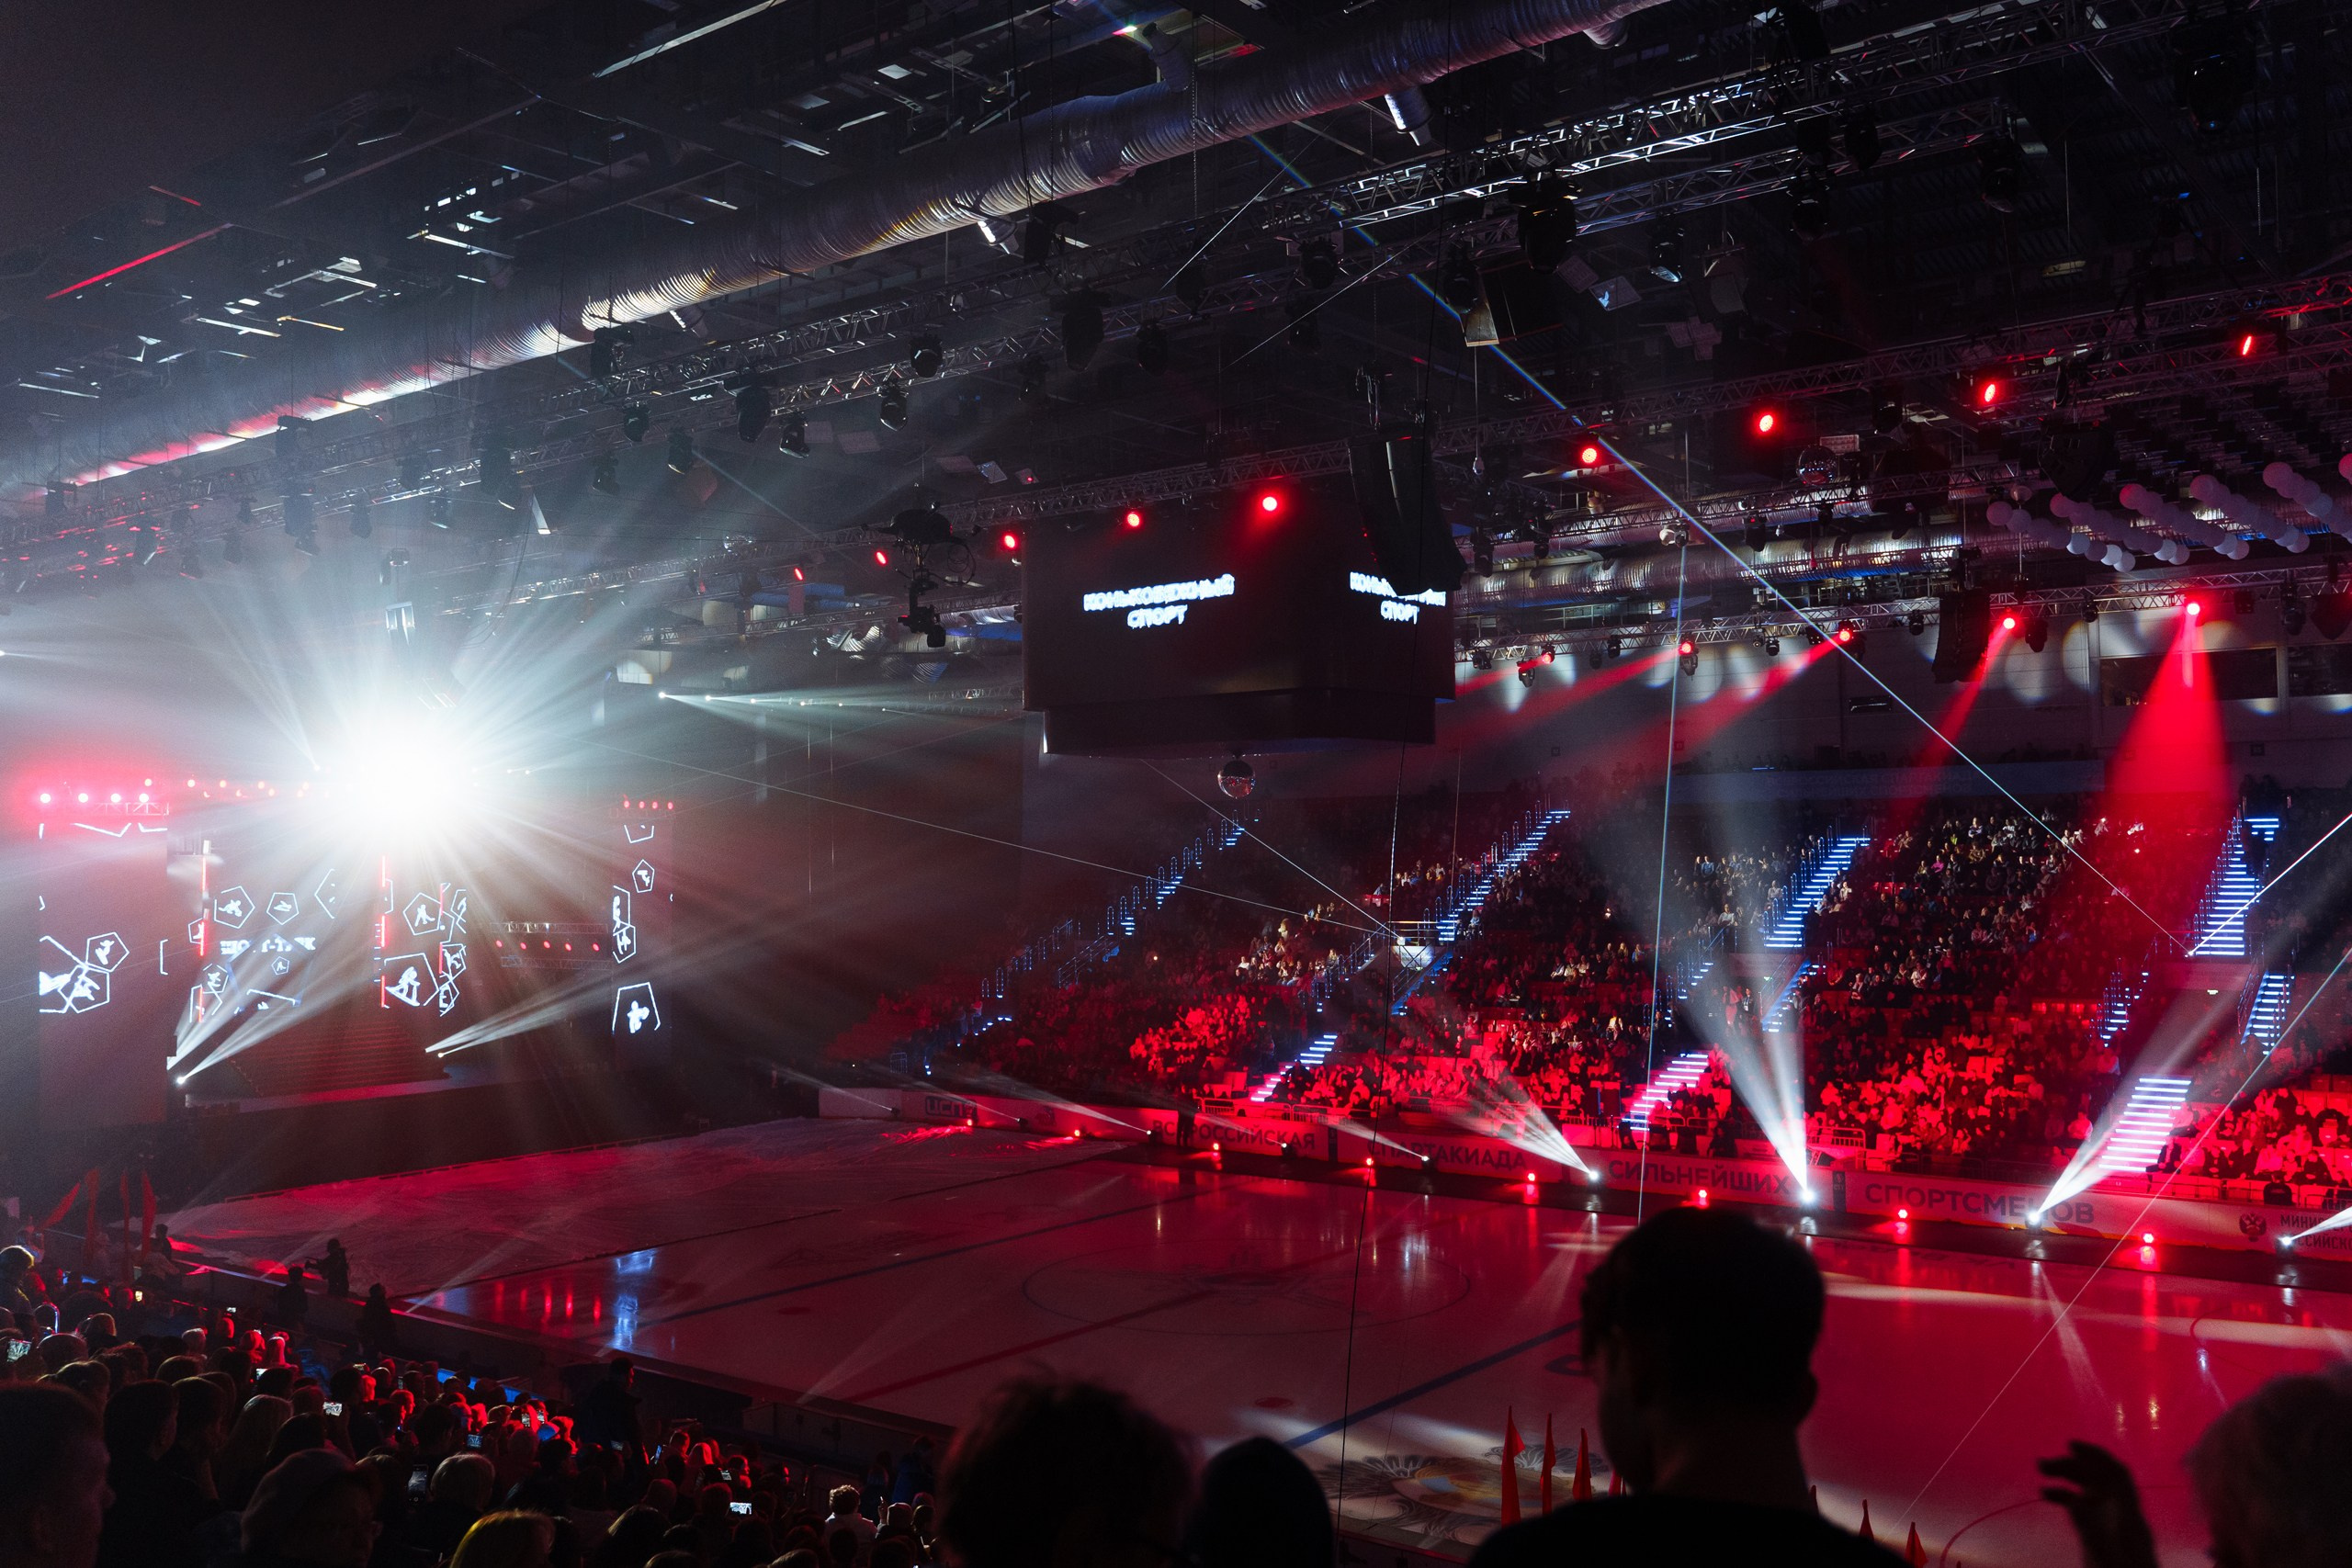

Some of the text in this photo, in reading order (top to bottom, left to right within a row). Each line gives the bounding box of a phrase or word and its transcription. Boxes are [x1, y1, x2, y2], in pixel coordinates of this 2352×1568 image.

[1126, 604, 1188, 628] СПОРТ
[1380, 598, 1419, 625] СПОРТ
[1609, 1160, 1791, 1193] СИЛЬНЕЙШИХ
